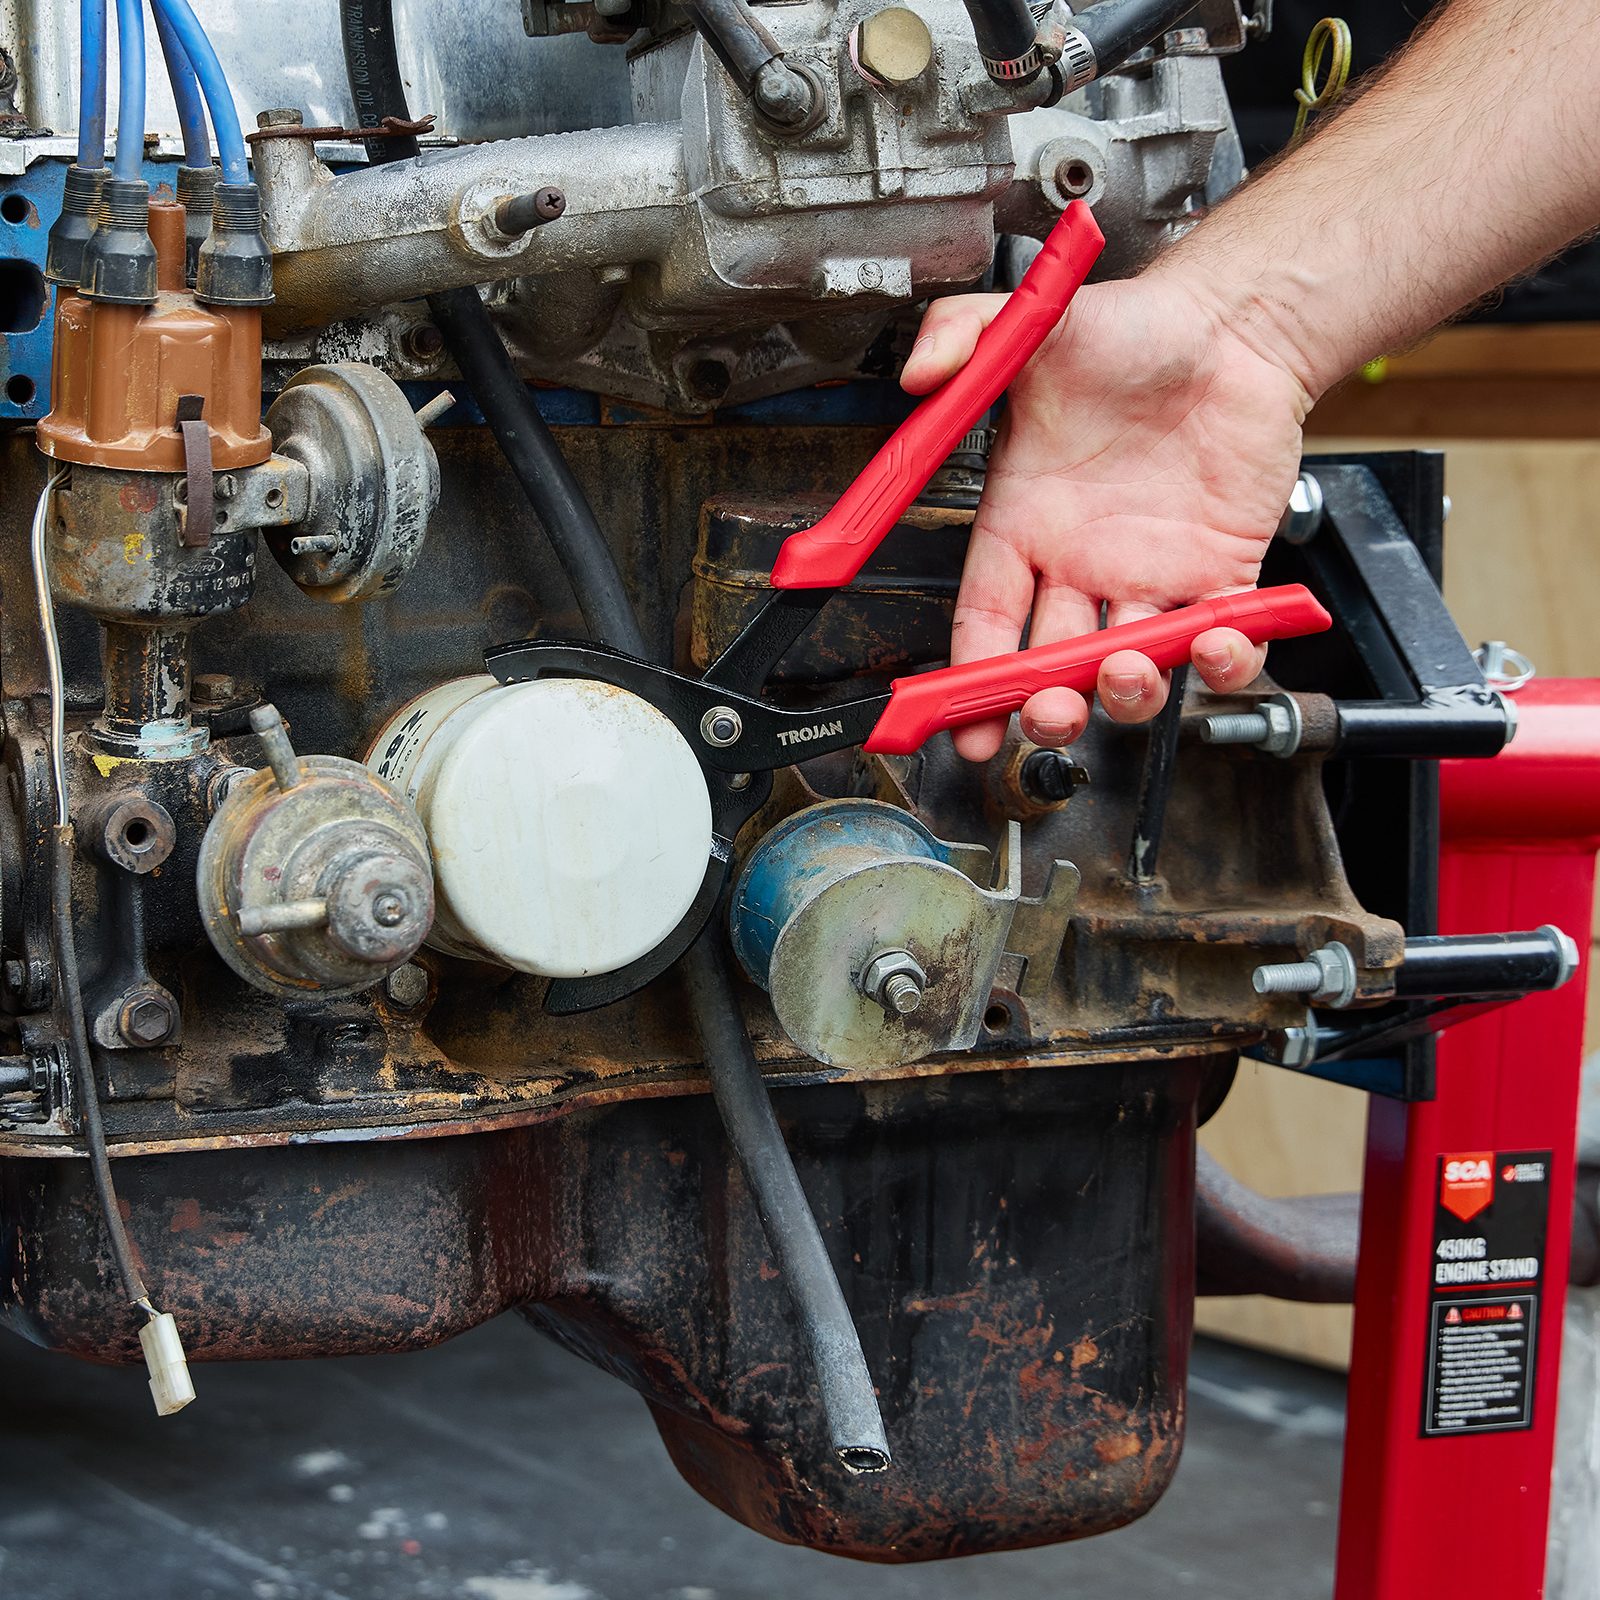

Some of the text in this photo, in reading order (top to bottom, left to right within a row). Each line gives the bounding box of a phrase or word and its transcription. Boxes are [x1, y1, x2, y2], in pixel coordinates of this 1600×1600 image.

[346, 3, 387, 158] TRANSMISSION OIL COLER
[776, 720, 843, 746] TROJAN
[1444, 1160, 1492, 1182] SCA
[1436, 1237, 1487, 1260] 450KG
[1435, 1257, 1538, 1284] ENGINE STAND
